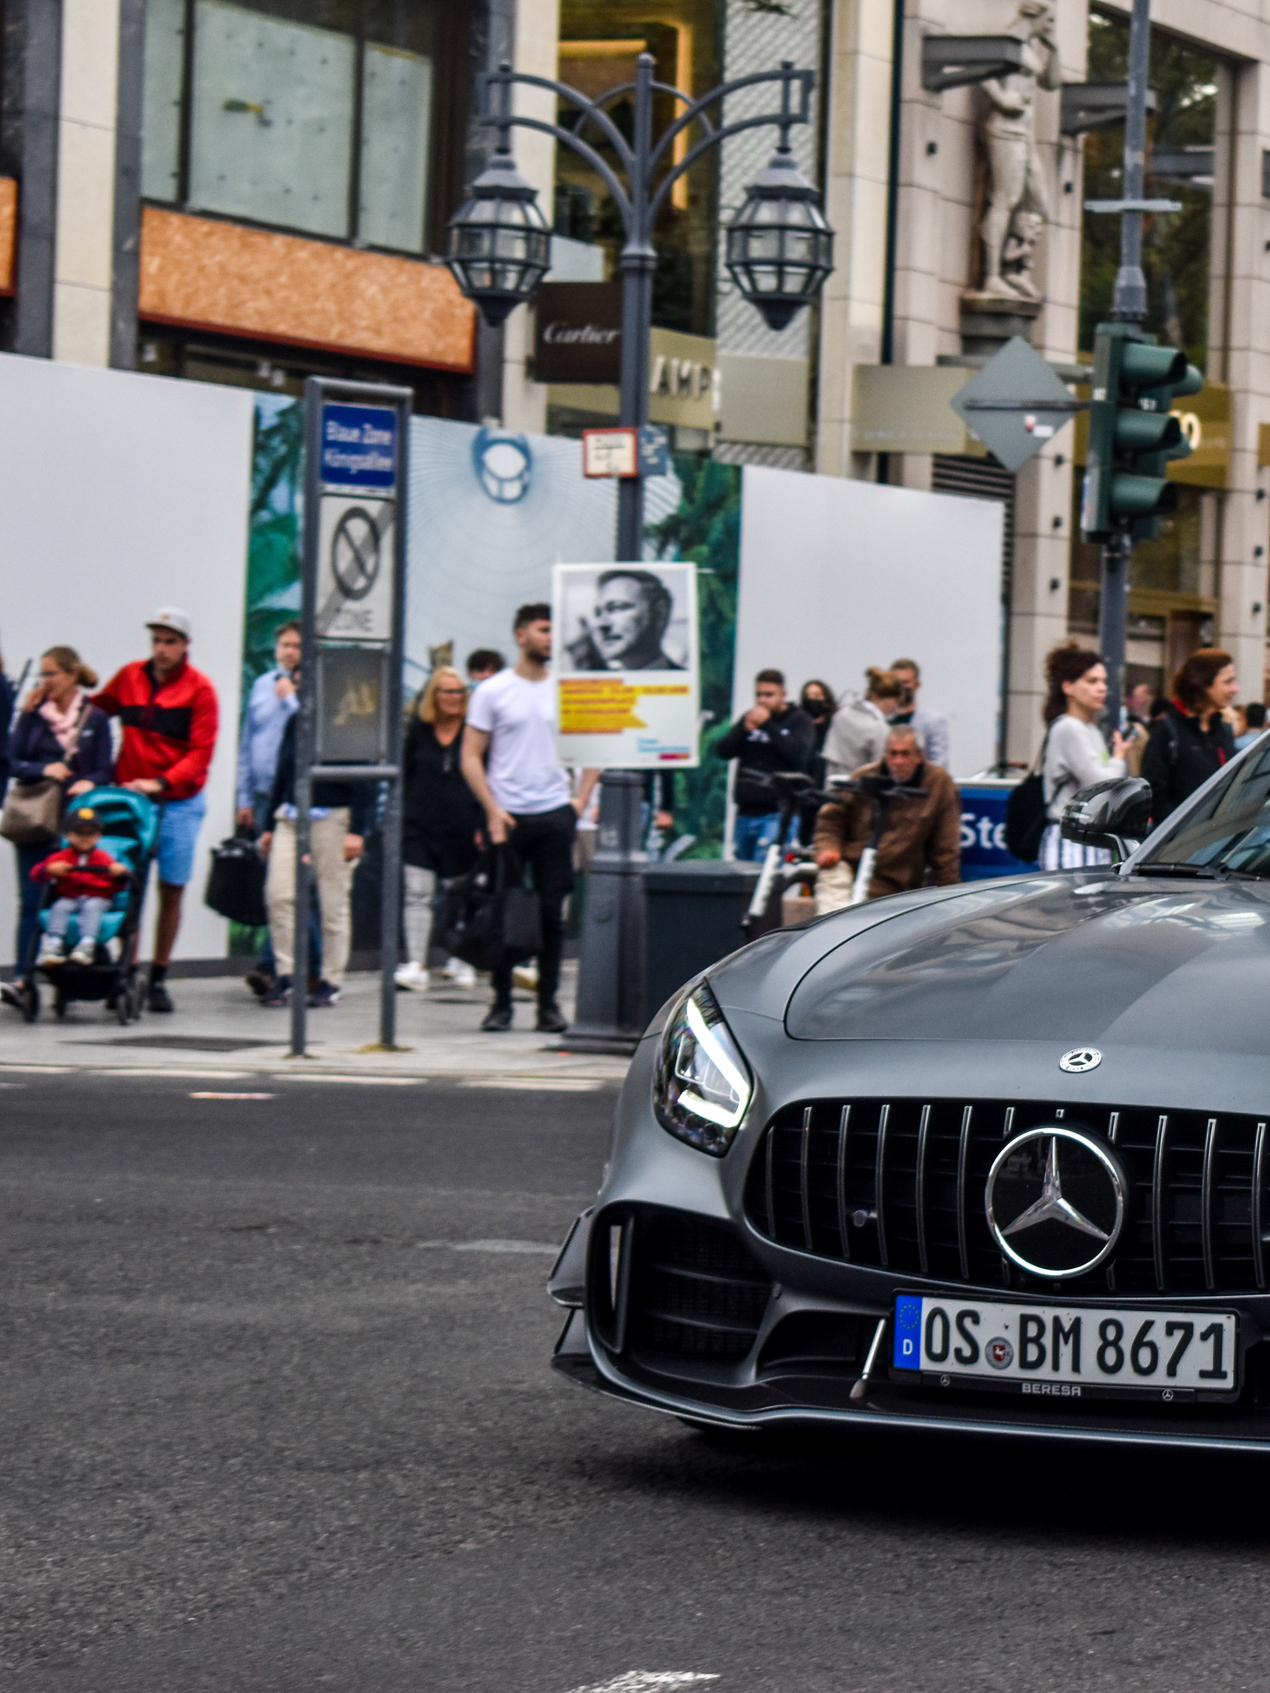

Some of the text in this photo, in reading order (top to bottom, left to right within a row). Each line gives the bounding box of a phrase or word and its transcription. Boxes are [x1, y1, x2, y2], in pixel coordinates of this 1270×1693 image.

[543, 322, 622, 345] Cartier
[903, 1339, 913, 1355] D
[924, 1306, 1229, 1380] OS BM 8671
[1022, 1383, 1082, 1398] BERESA
